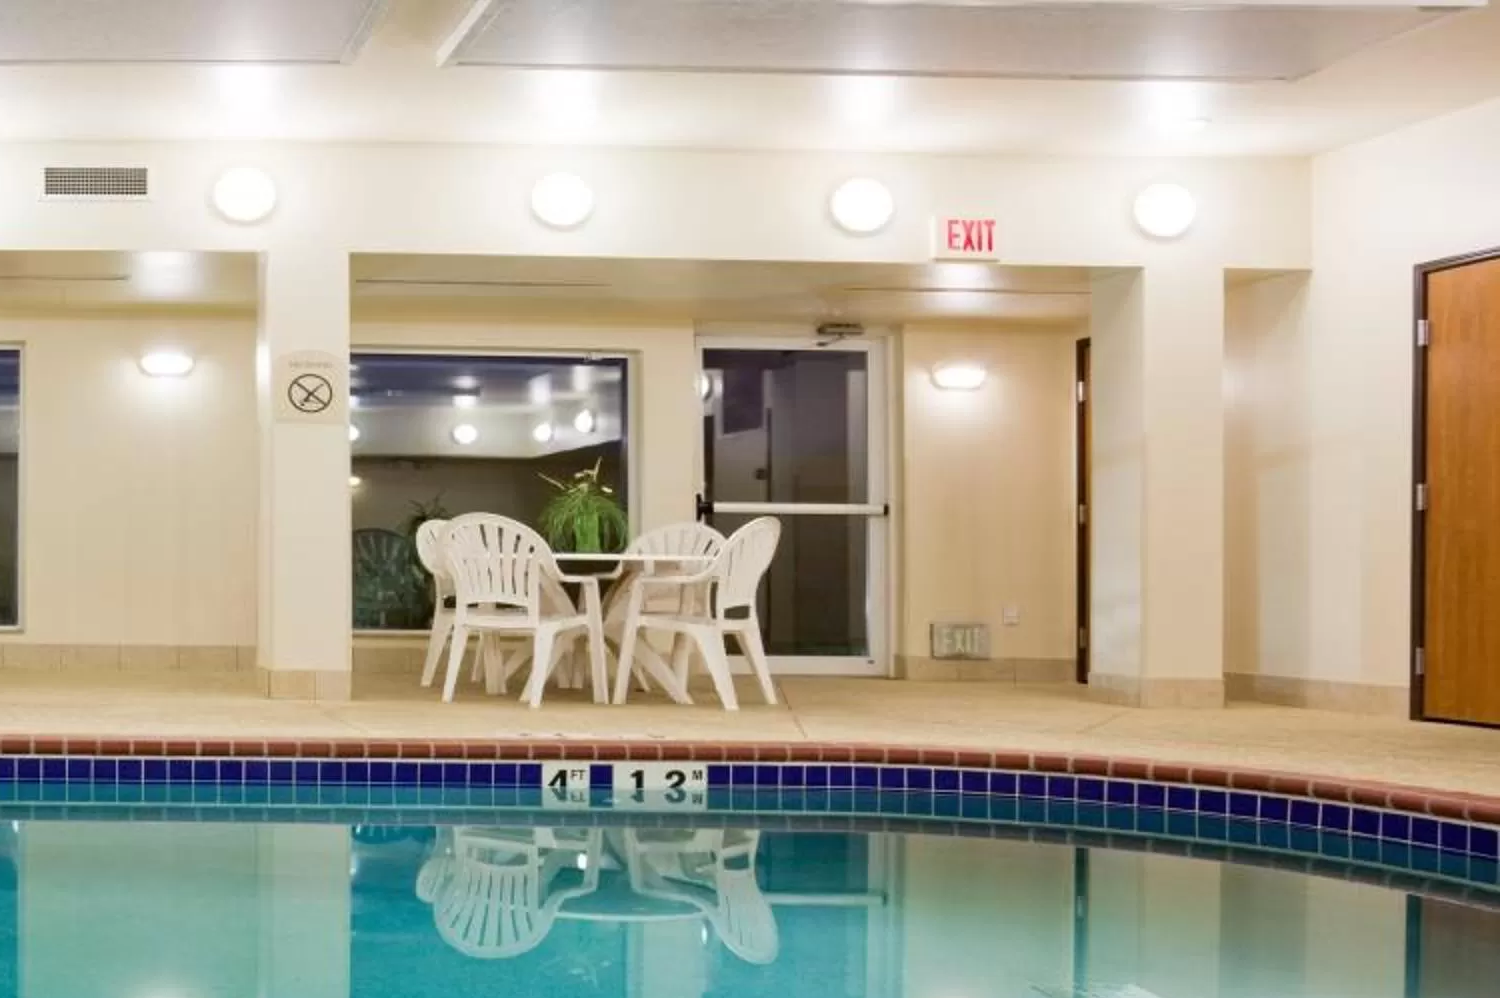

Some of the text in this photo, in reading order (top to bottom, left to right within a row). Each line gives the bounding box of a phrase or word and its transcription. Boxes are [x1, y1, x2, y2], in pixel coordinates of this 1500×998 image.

[947, 219, 996, 252] EXIT
[570, 769, 586, 780] FT
[692, 769, 703, 780] M
